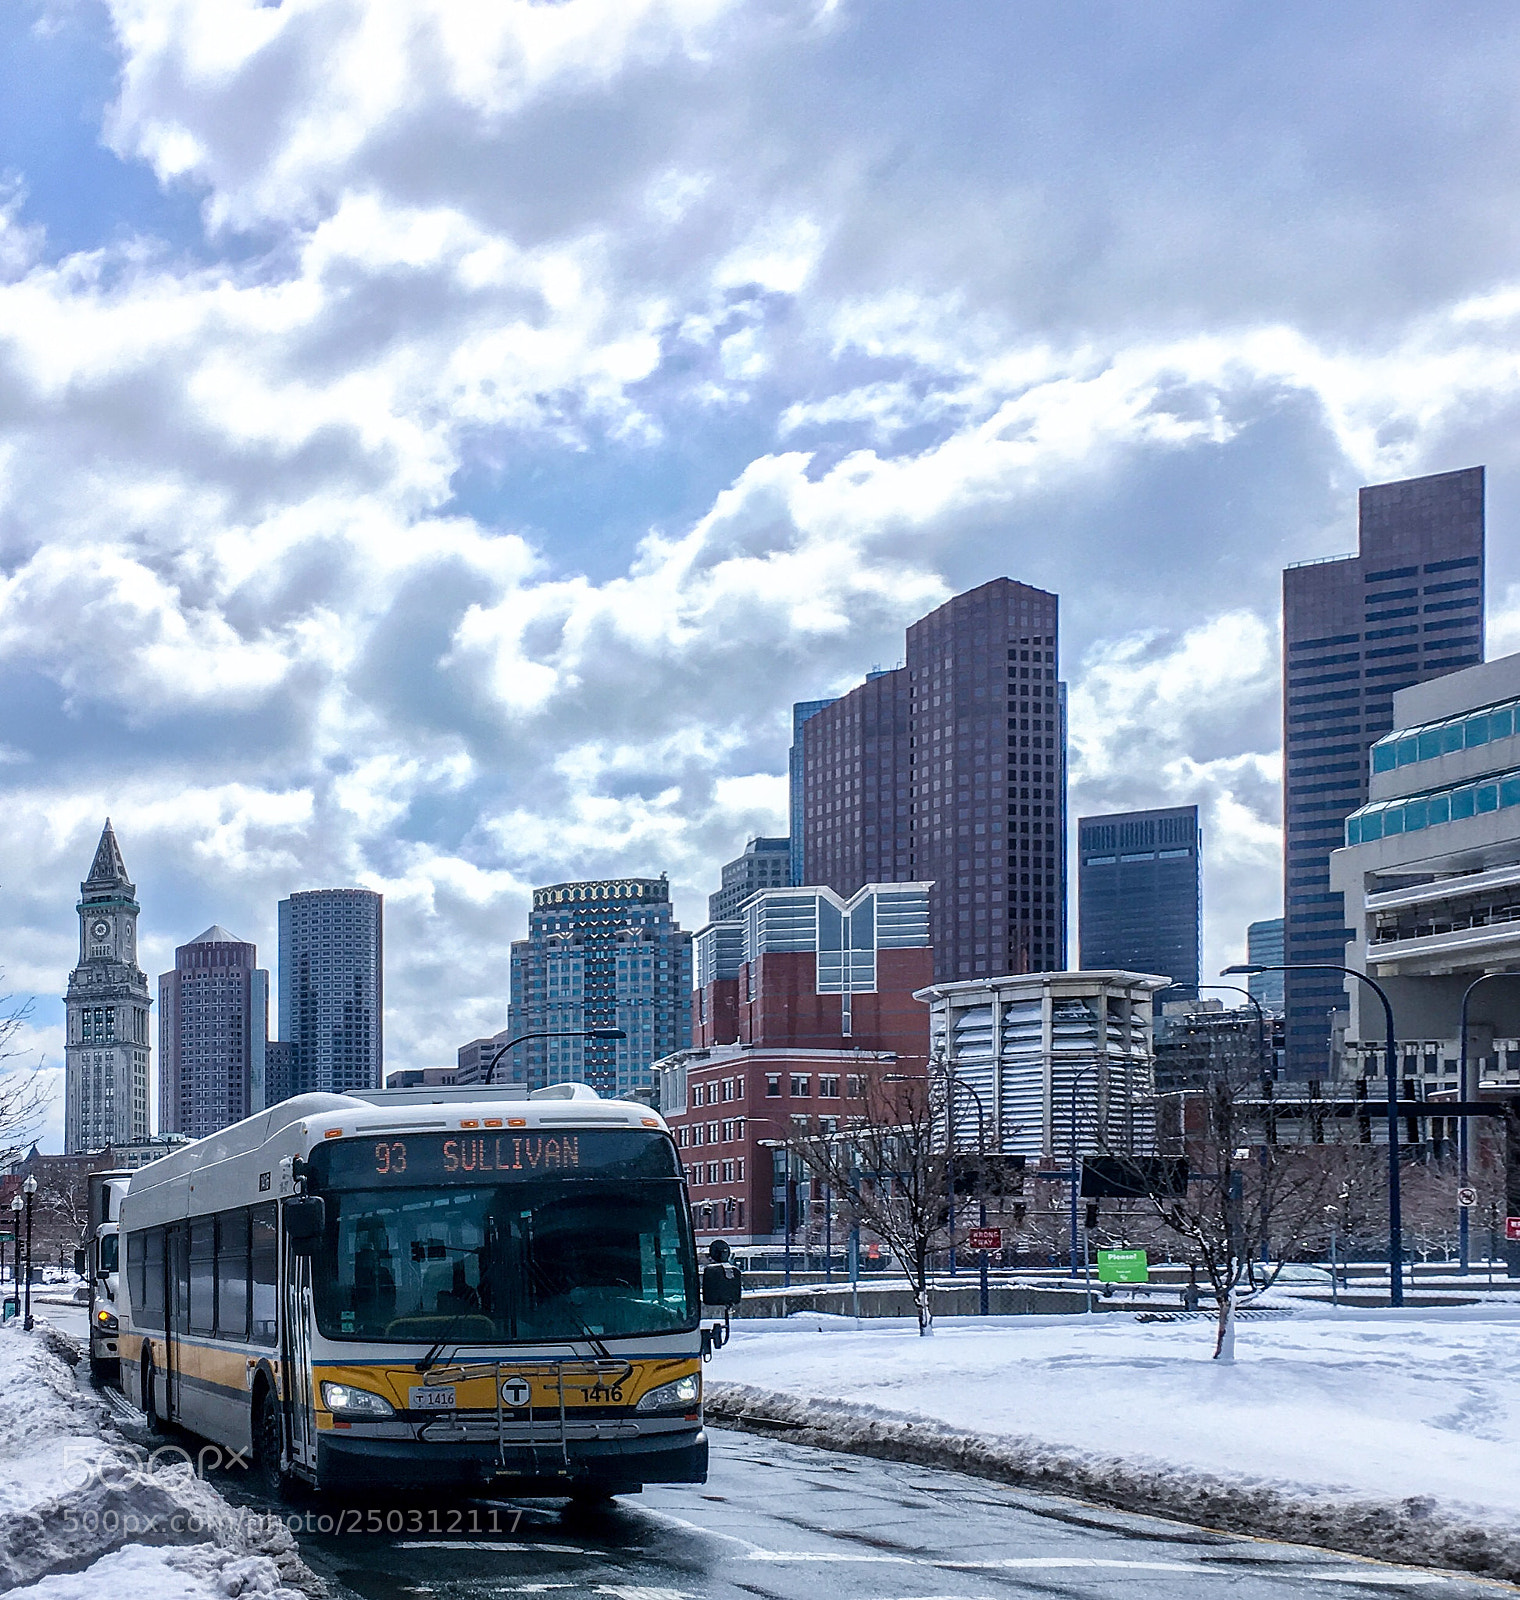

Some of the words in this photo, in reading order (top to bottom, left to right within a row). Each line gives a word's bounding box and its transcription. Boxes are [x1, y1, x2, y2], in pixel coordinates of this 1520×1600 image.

[375, 1142, 407, 1174] 93
[443, 1136, 579, 1171] SULLIVAN
[1107, 1253, 1137, 1261] Please!
[428, 1392, 454, 1405] 1416
[506, 1384, 527, 1402] T
[581, 1386, 623, 1403] 1416
